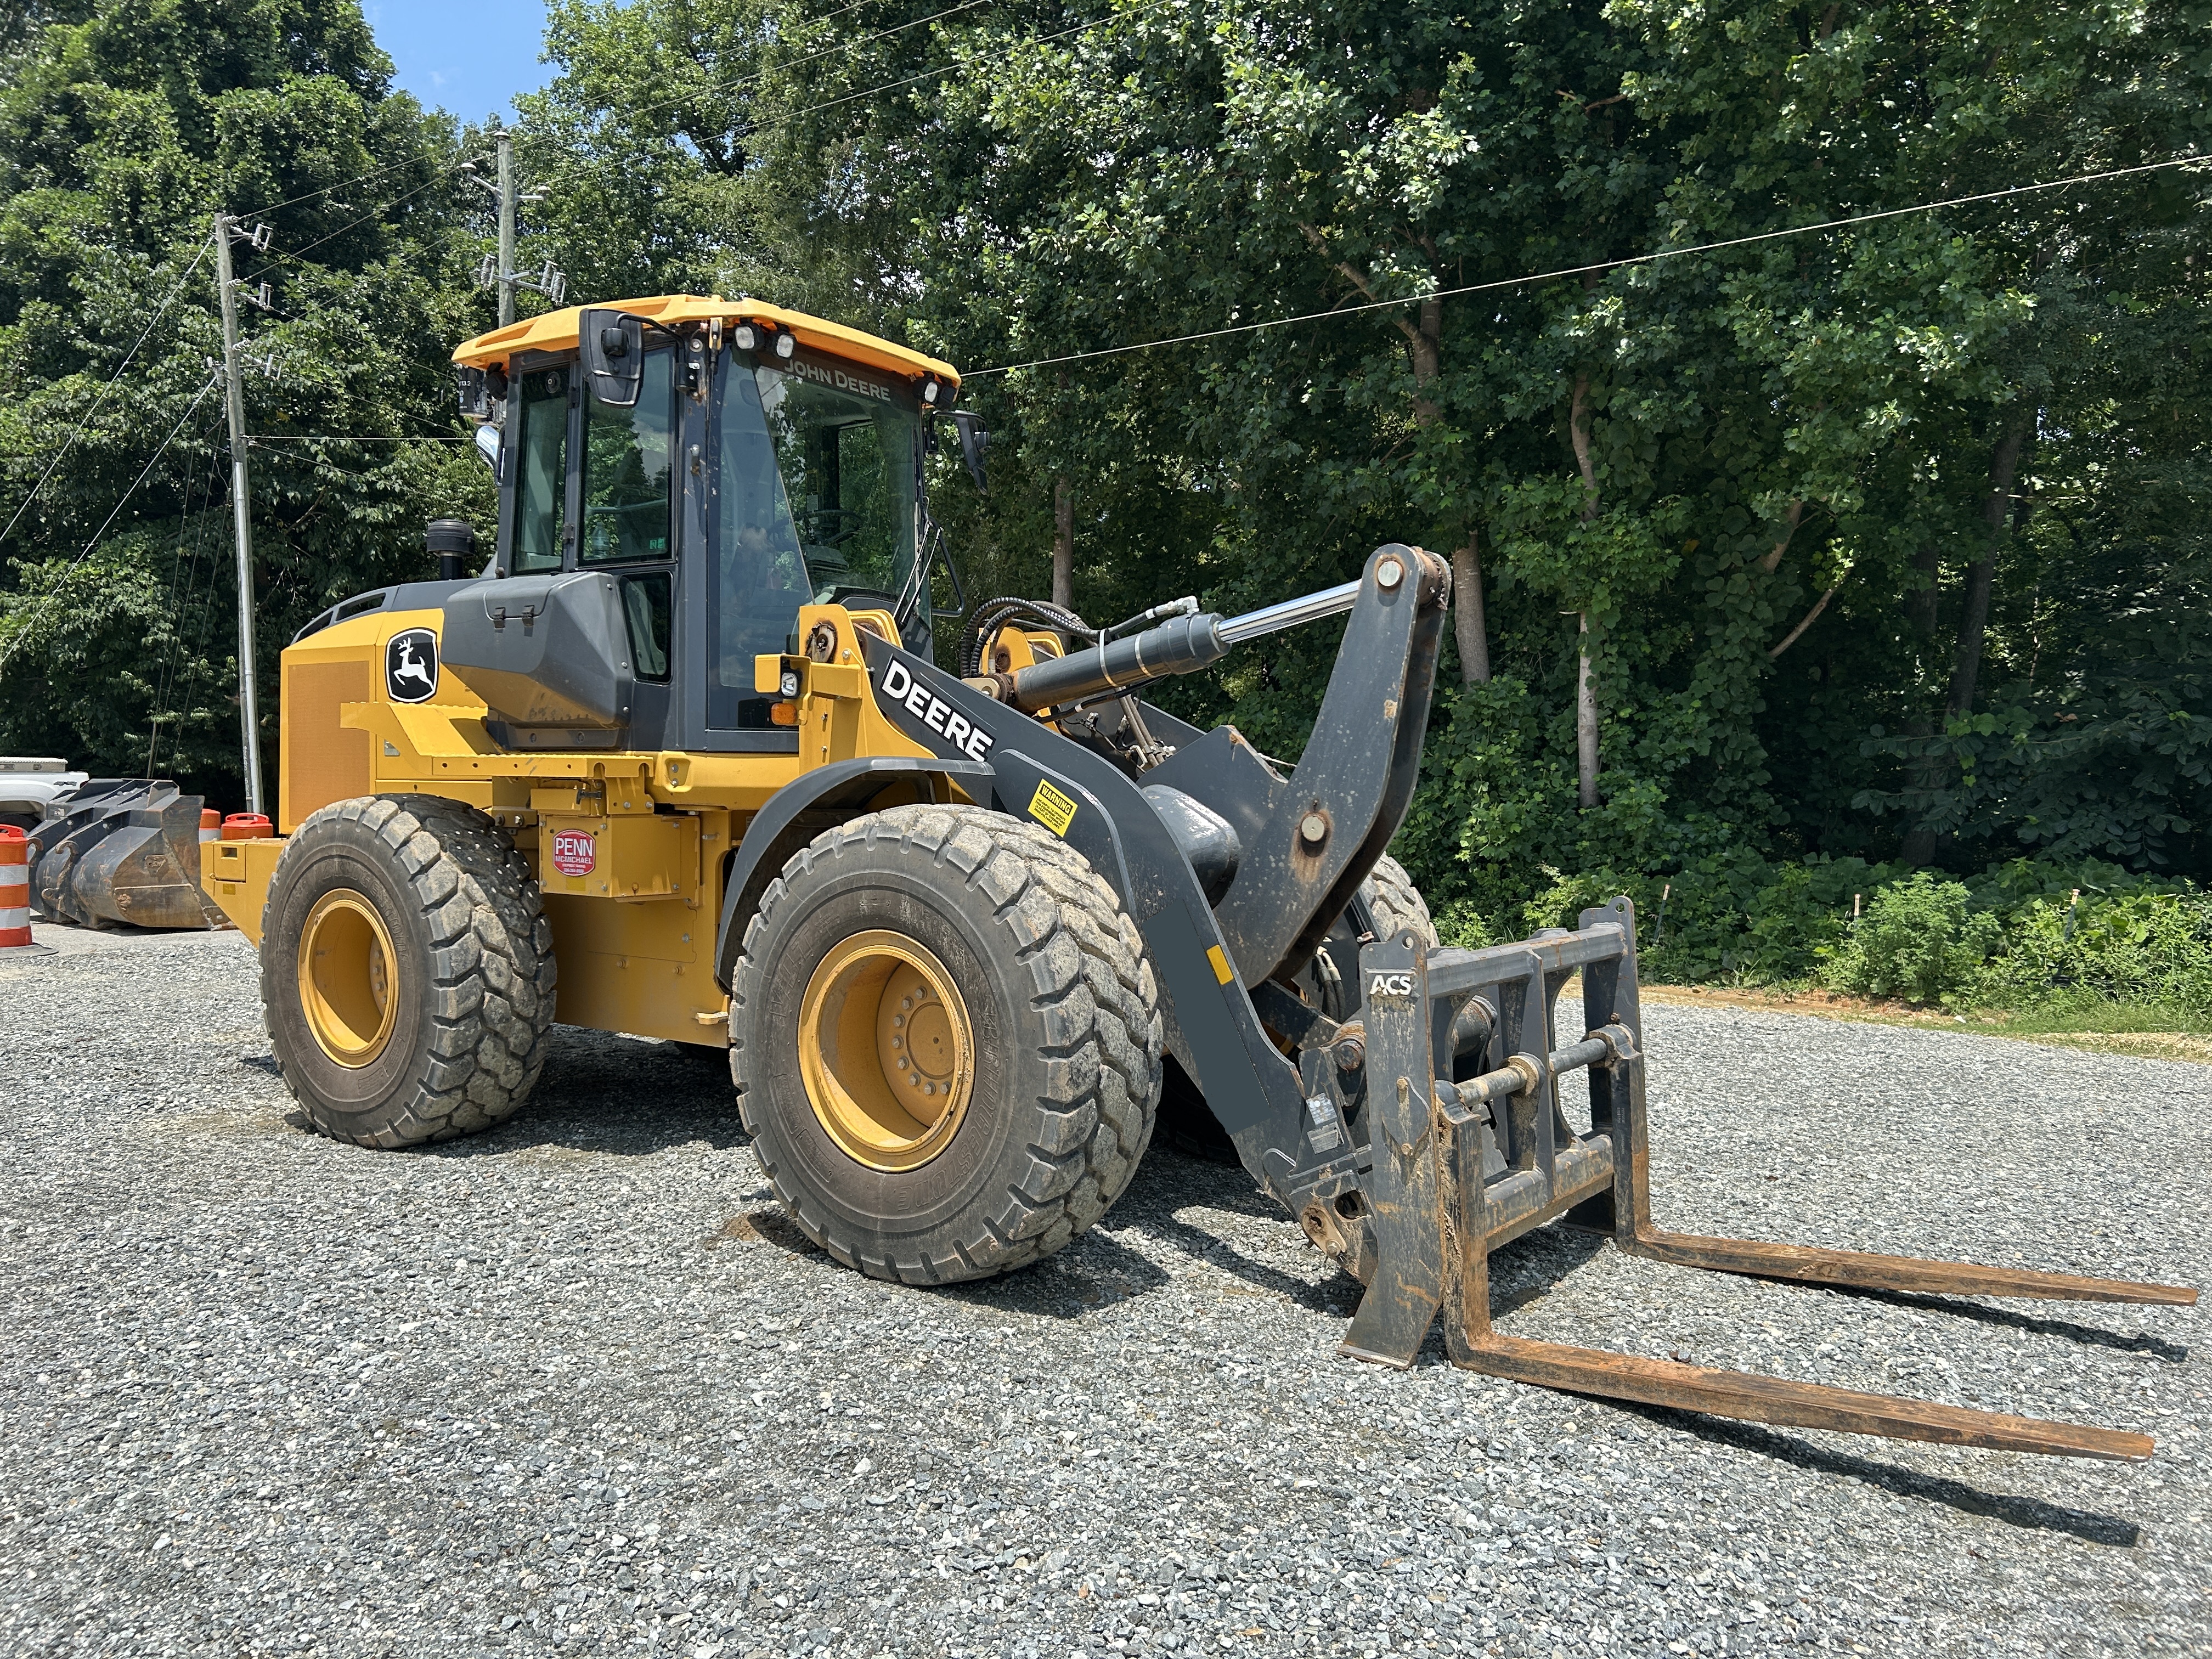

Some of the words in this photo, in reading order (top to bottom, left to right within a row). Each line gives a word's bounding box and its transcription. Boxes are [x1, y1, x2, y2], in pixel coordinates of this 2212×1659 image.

[784, 359, 832, 385] JOHN
[834, 370, 891, 402] DEERE
[881, 659, 994, 762] DEERE
[1040, 785, 1071, 815] WARNING
[555, 837, 593, 857] PENN
[555, 855, 593, 864] MCMICHAEL
[1369, 974, 1412, 995] ACS
[898, 1008, 1000, 1211] BRIDGESTONE
